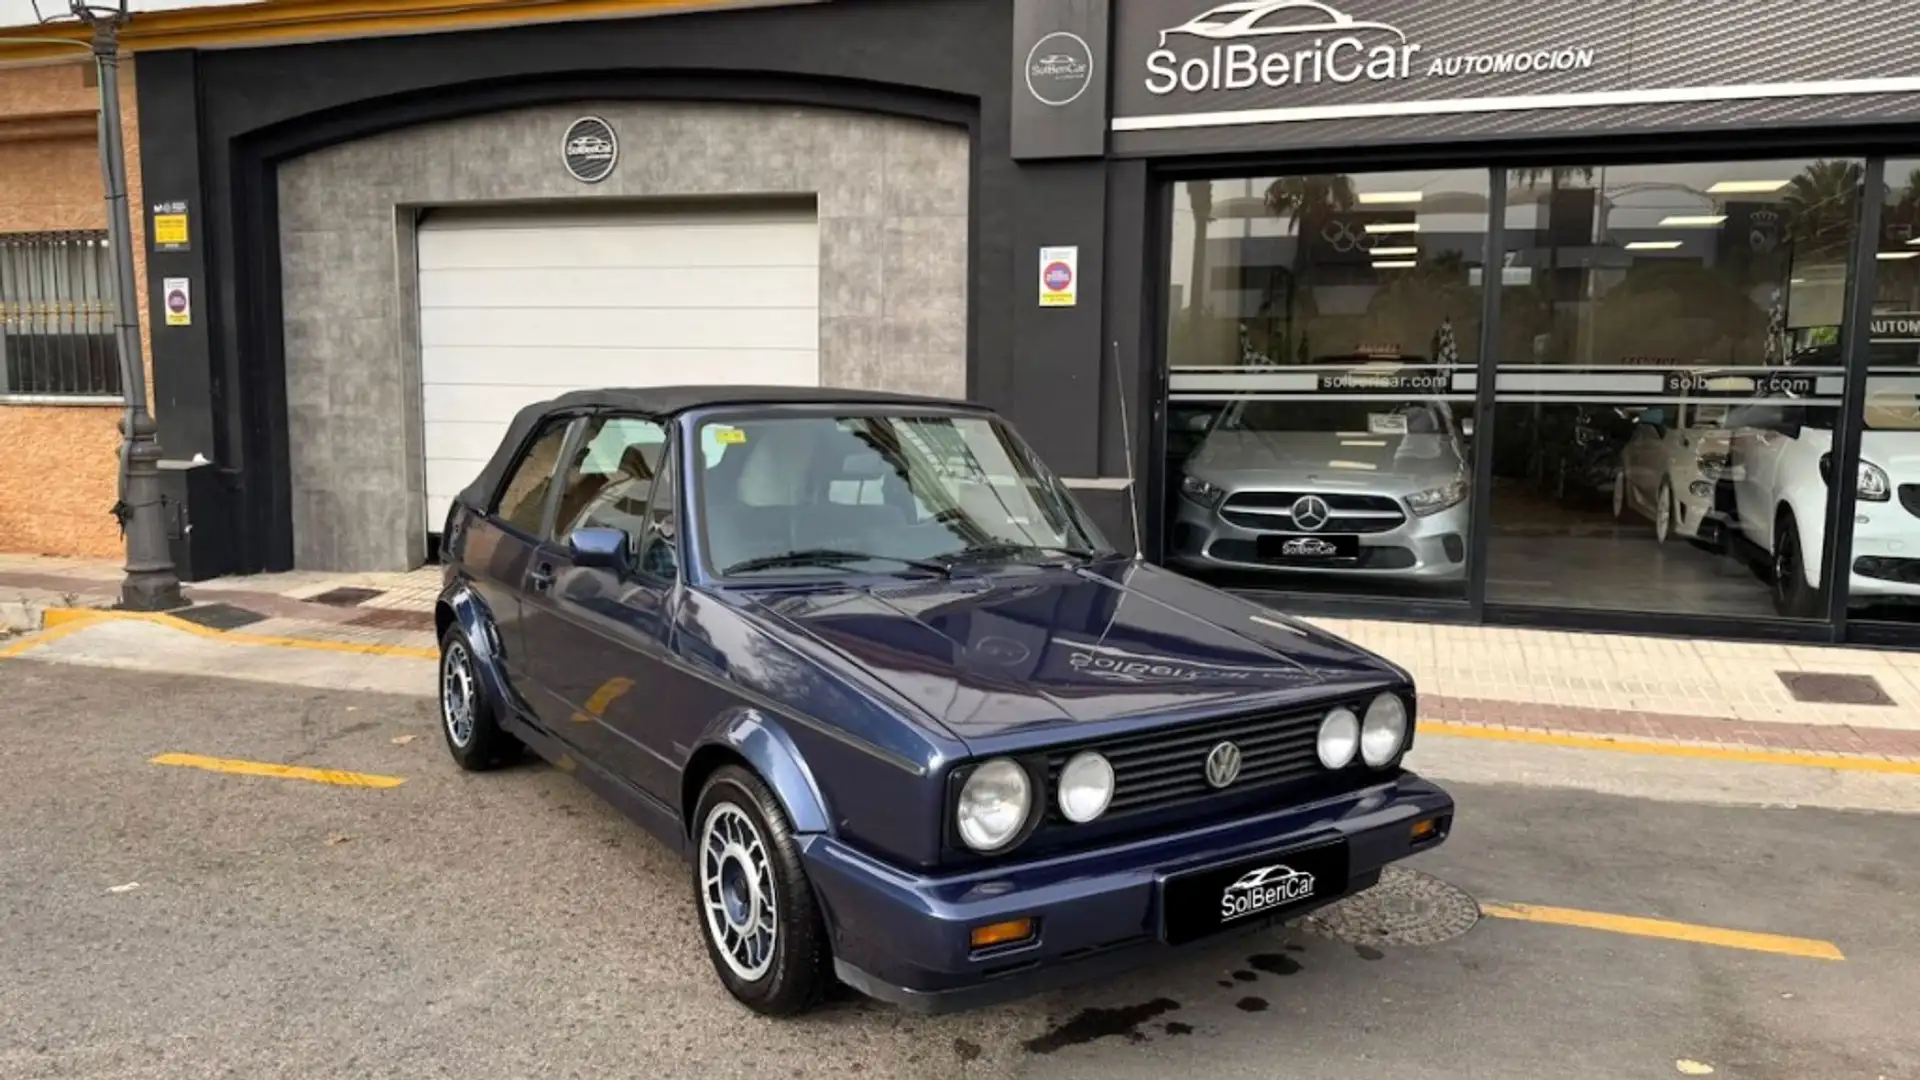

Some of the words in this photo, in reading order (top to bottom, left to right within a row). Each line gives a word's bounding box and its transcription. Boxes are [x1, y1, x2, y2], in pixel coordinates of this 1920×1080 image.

[1145, 37, 1421, 94] SolBeriCar
[1427, 46, 1594, 77] AUTOMOCIÓN
[1221, 876, 1315, 917] SolBeriCar
